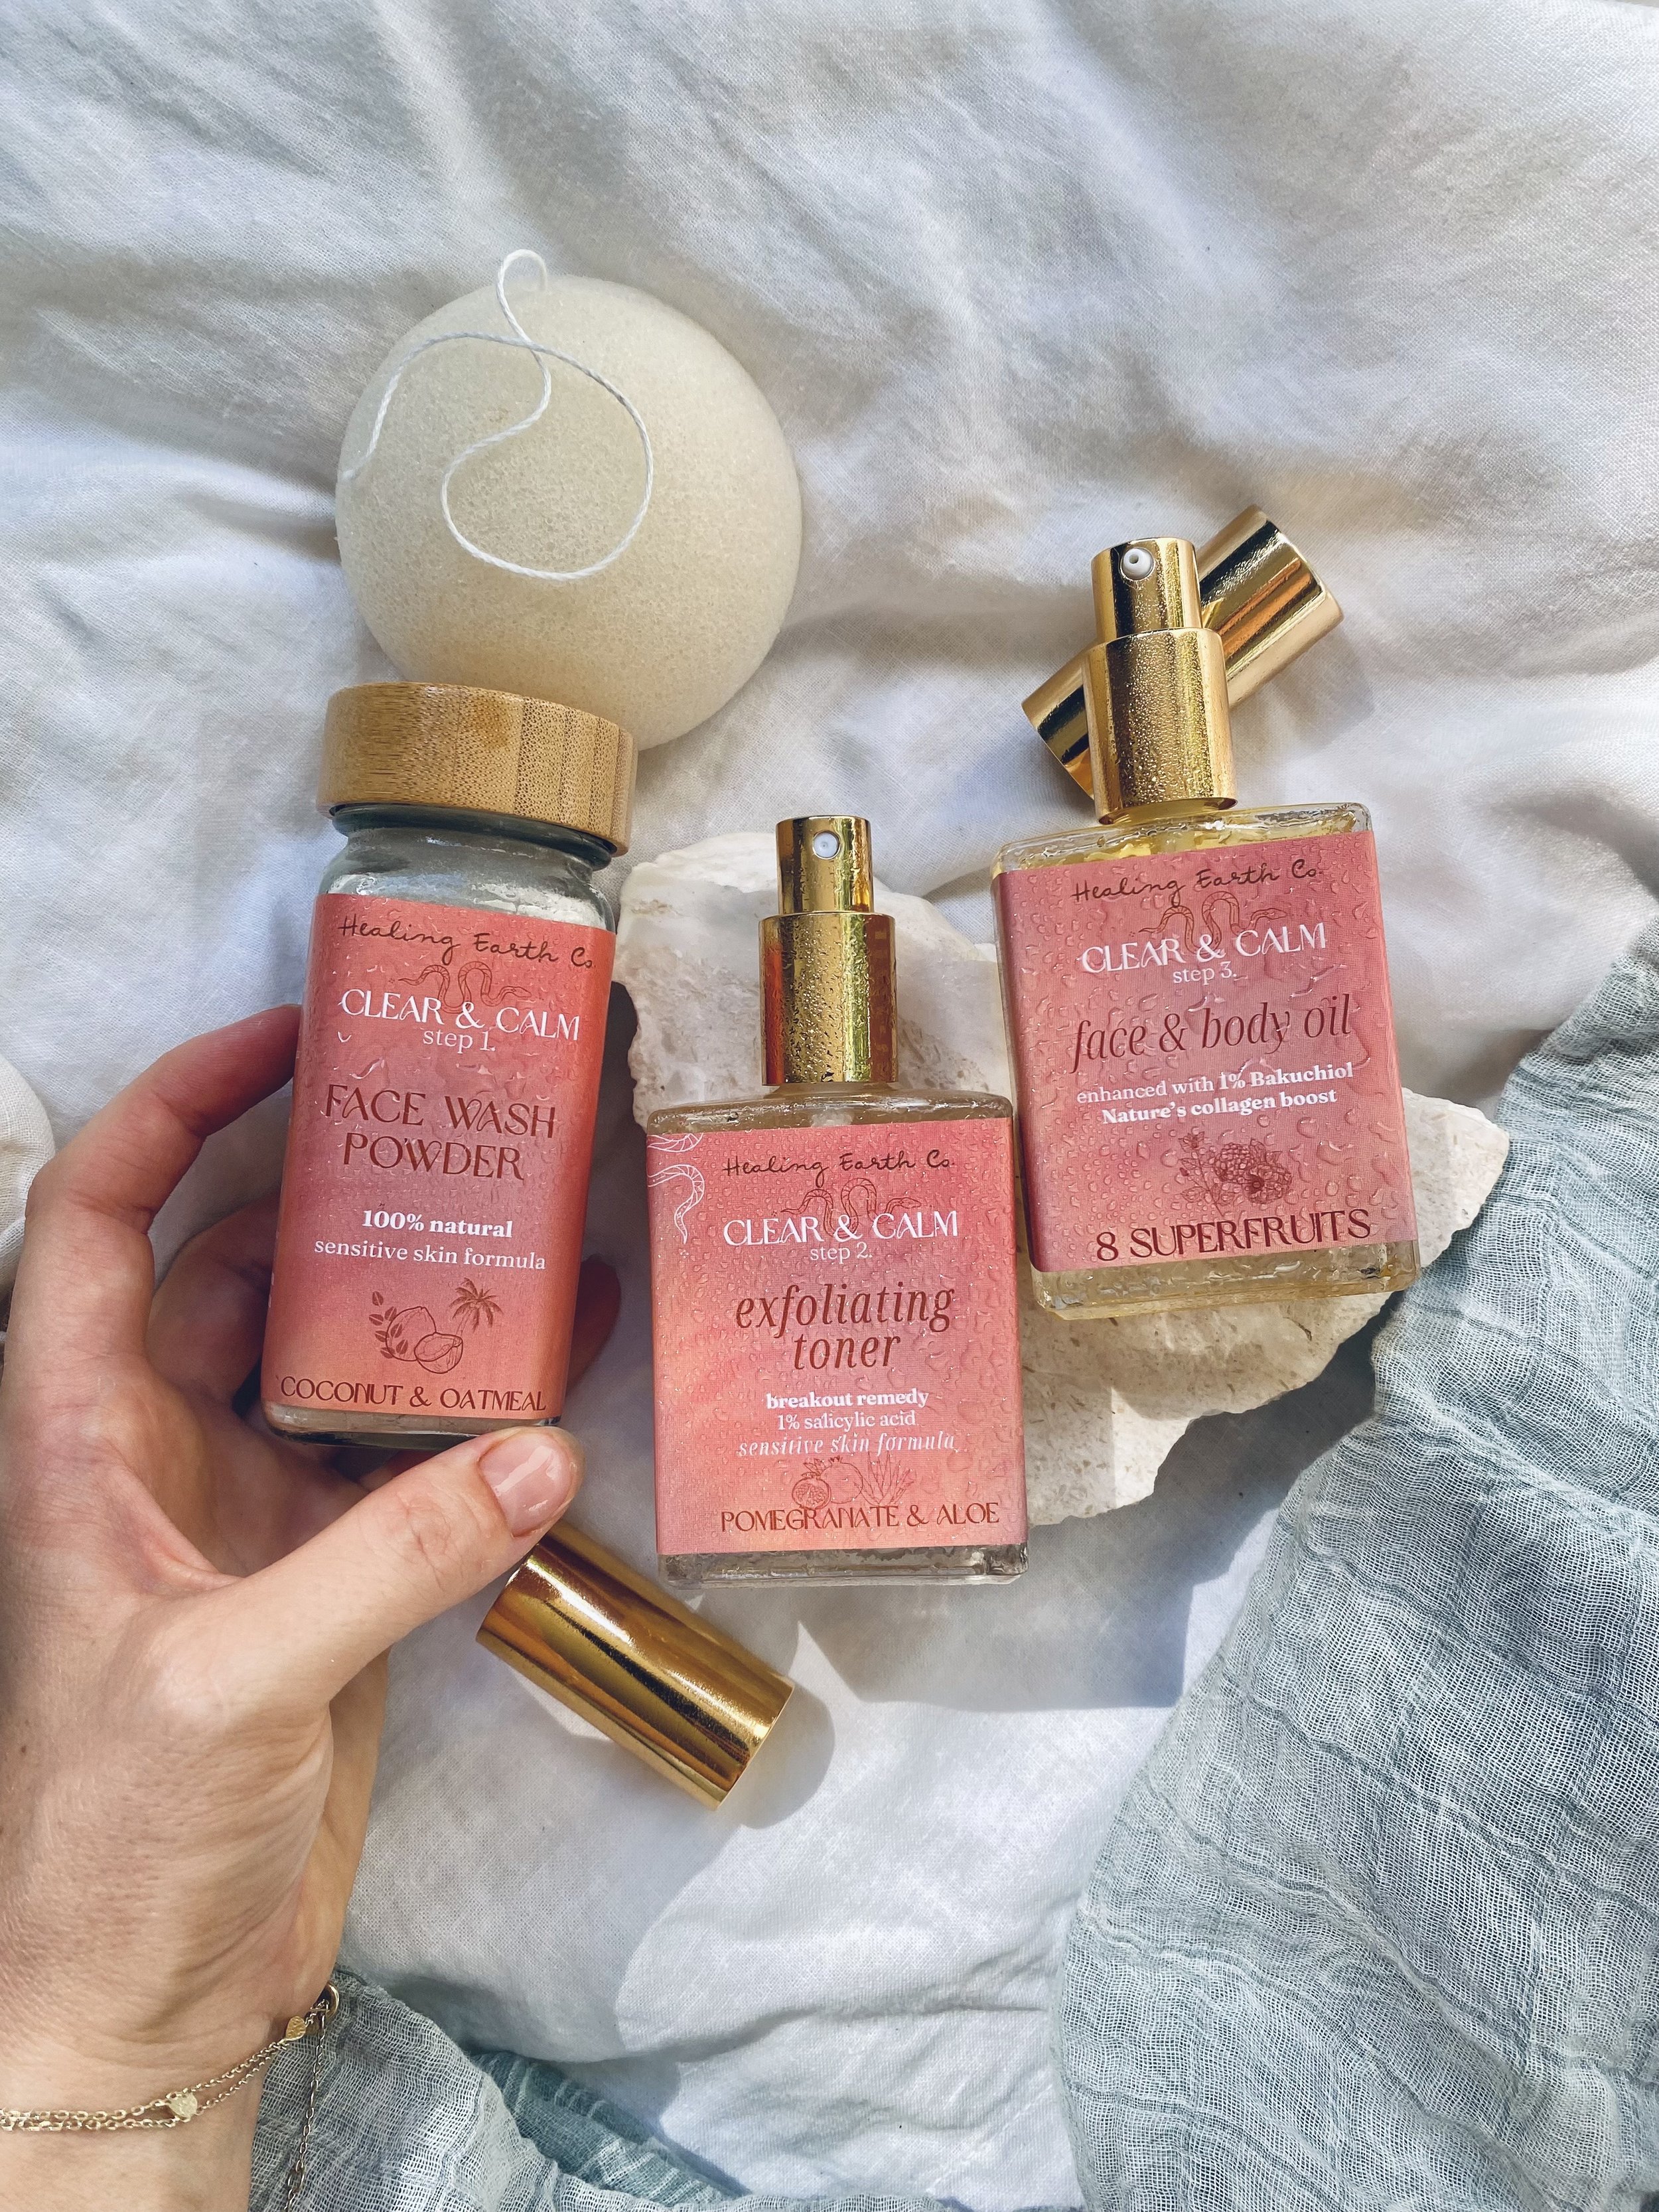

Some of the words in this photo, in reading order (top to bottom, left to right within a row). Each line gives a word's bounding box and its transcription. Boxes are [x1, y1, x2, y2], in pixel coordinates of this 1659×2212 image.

[1072, 877, 1185, 907] Healing
[1196, 863, 1280, 889] Earth
[338, 914, 461, 965] Healing
[474, 933, 559, 963] Earth
[1081, 938, 1186, 974] CLEAR
[1196, 934, 1225, 962] &
[1235, 922, 1327, 958] CALM
[1173, 964, 1216, 986] step
[1219, 961, 1238, 980] 3.
[341, 989, 444, 1025] CLEAR
[455, 1002, 485, 1029] &
[496, 1007, 580, 1041] CALM
[423, 1029, 472, 1054] step
[1068, 1019, 1147, 1074] face
[1159, 1013, 1189, 1053] &
[1201, 1002, 1291, 1055] body
[1303, 994, 1352, 1039] oil
[1076, 1080, 1167, 1104] enhanced
[1171, 1075, 1215, 1095] with
[1218, 1070, 1246, 1090] 1%
[1250, 1061, 1354, 1087] Bakuchiol
[325, 1084, 426, 1126] FACE
[445, 1096, 555, 1138] WASH
[1102, 1101, 1187, 1125] Nature's
[1190, 1095, 1276, 1121] collagen
[1280, 1088, 1338, 1107] boost
[344, 1132, 525, 1180] POWDER
[723, 1157, 831, 1187] Healing
[839, 1151, 916, 1172] Earth
[362, 1210, 425, 1232] 100%
[430, 1218, 512, 1238] natural
[723, 1216, 824, 1246] CLEAR
[833, 1214, 863, 1242] &
[873, 1211, 958, 1238] CALM
[1096, 1232, 1119, 1261] 8
[1129, 1209, 1372, 1258] SUPERFRUITS
[315, 1239, 408, 1260] sensitive
[413, 1244, 458, 1264] skin
[464, 1247, 546, 1270] formula
[810, 1244, 851, 1264] step
[856, 1242, 873, 1259] 2.
[735, 1281, 955, 1339] exfoliating
[794, 1332, 902, 1370] toner
[281, 1376, 403, 1405] COCONUT
[409, 1386, 432, 1408] &
[440, 1388, 546, 1411] OATMEAL
[766, 1392, 853, 1410] breakout
[857, 1388, 929, 1408] remedy
[778, 1413, 800, 1430] 1%
[804, 1410, 875, 1430] salicylic
[879, 1410, 916, 1426] acid
[737, 1436, 824, 1457] sensitive
[830, 1434, 870, 1453] skin
[876, 1431, 956, 1457] formula
[721, 1505, 900, 1532] POMEGRANATE
[906, 1504, 929, 1527] &
[936, 1503, 1000, 1524] ALOE
